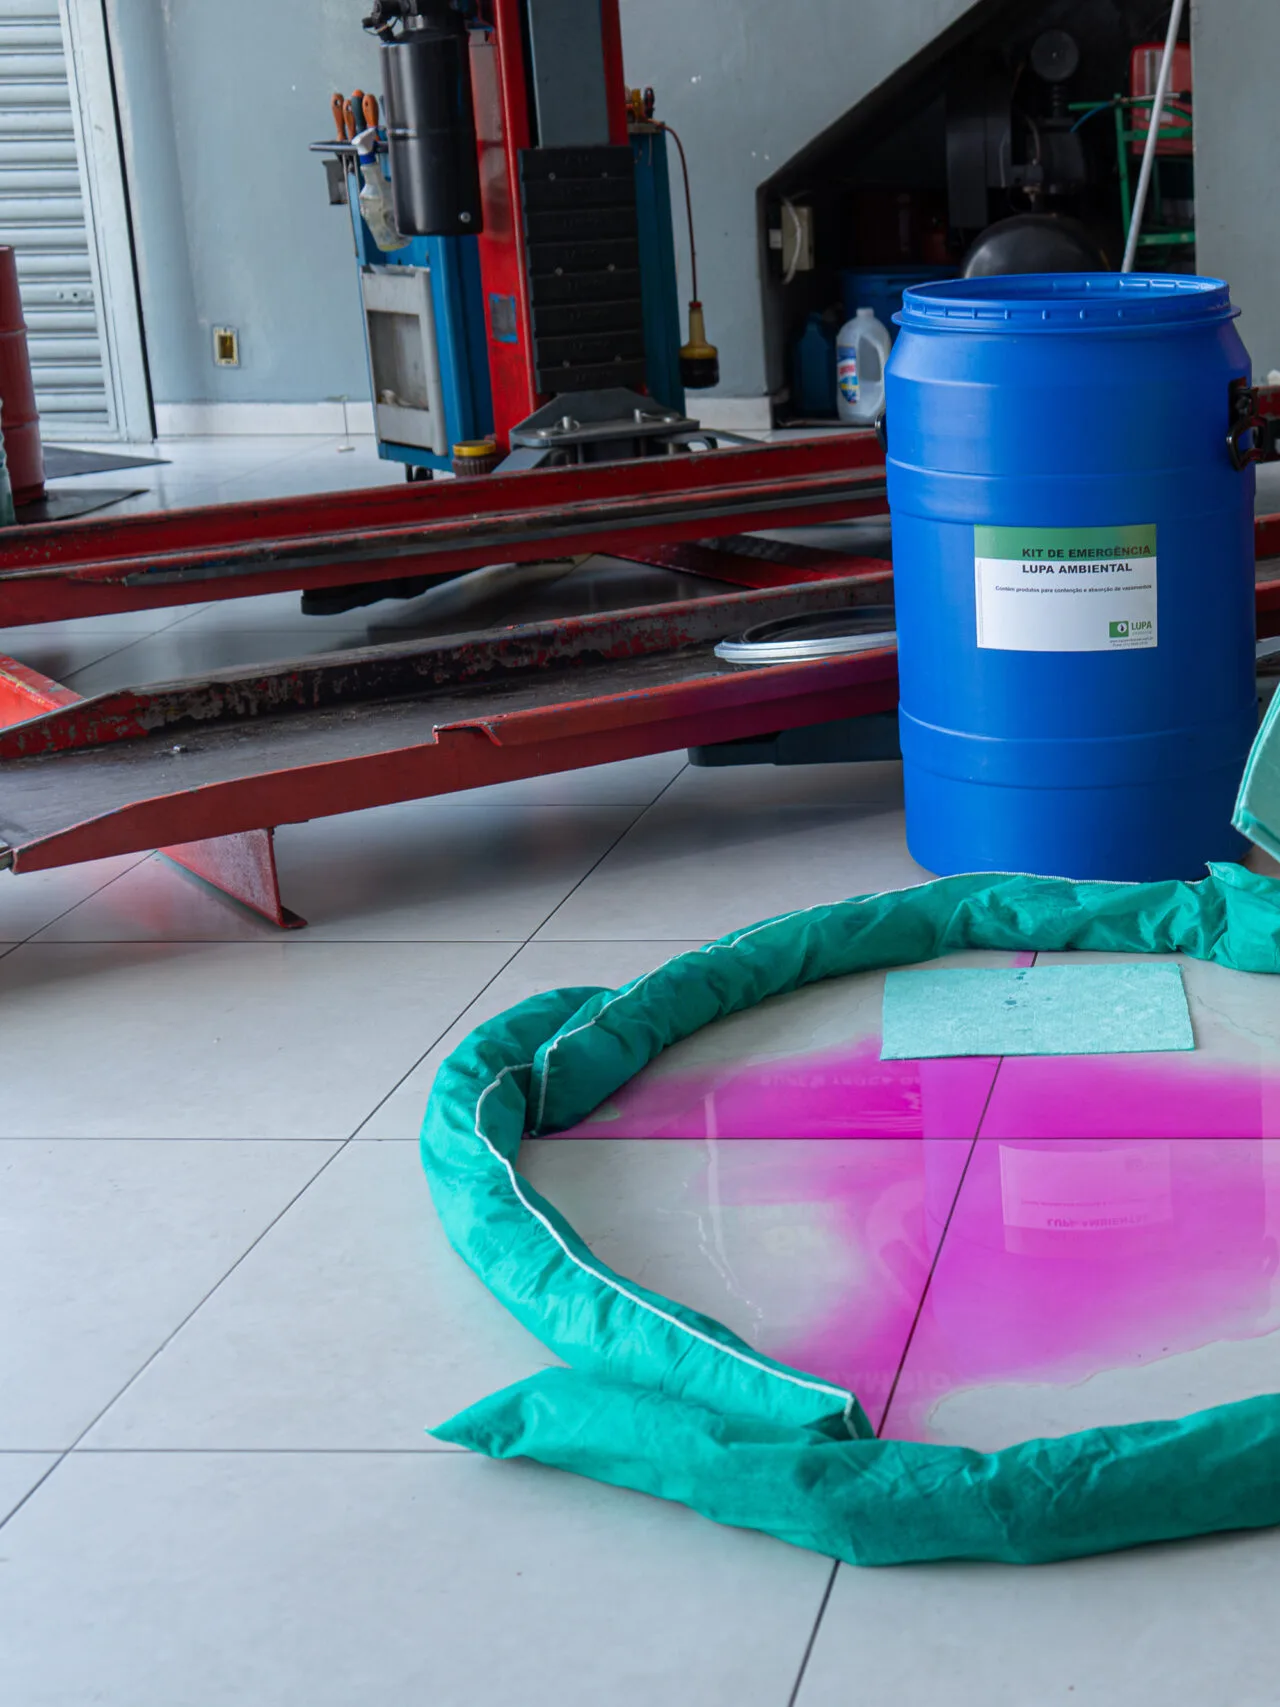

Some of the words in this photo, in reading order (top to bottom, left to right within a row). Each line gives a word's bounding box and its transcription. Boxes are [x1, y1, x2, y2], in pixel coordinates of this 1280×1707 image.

[1022, 548, 1043, 558] KIT
[1048, 549, 1064, 558] DE
[1068, 545, 1151, 558] EMERGÊNCIA
[1022, 565, 1054, 574] LUPA
[1058, 563, 1132, 574] AMBIENTAL
[1131, 621, 1153, 631] LUPA
